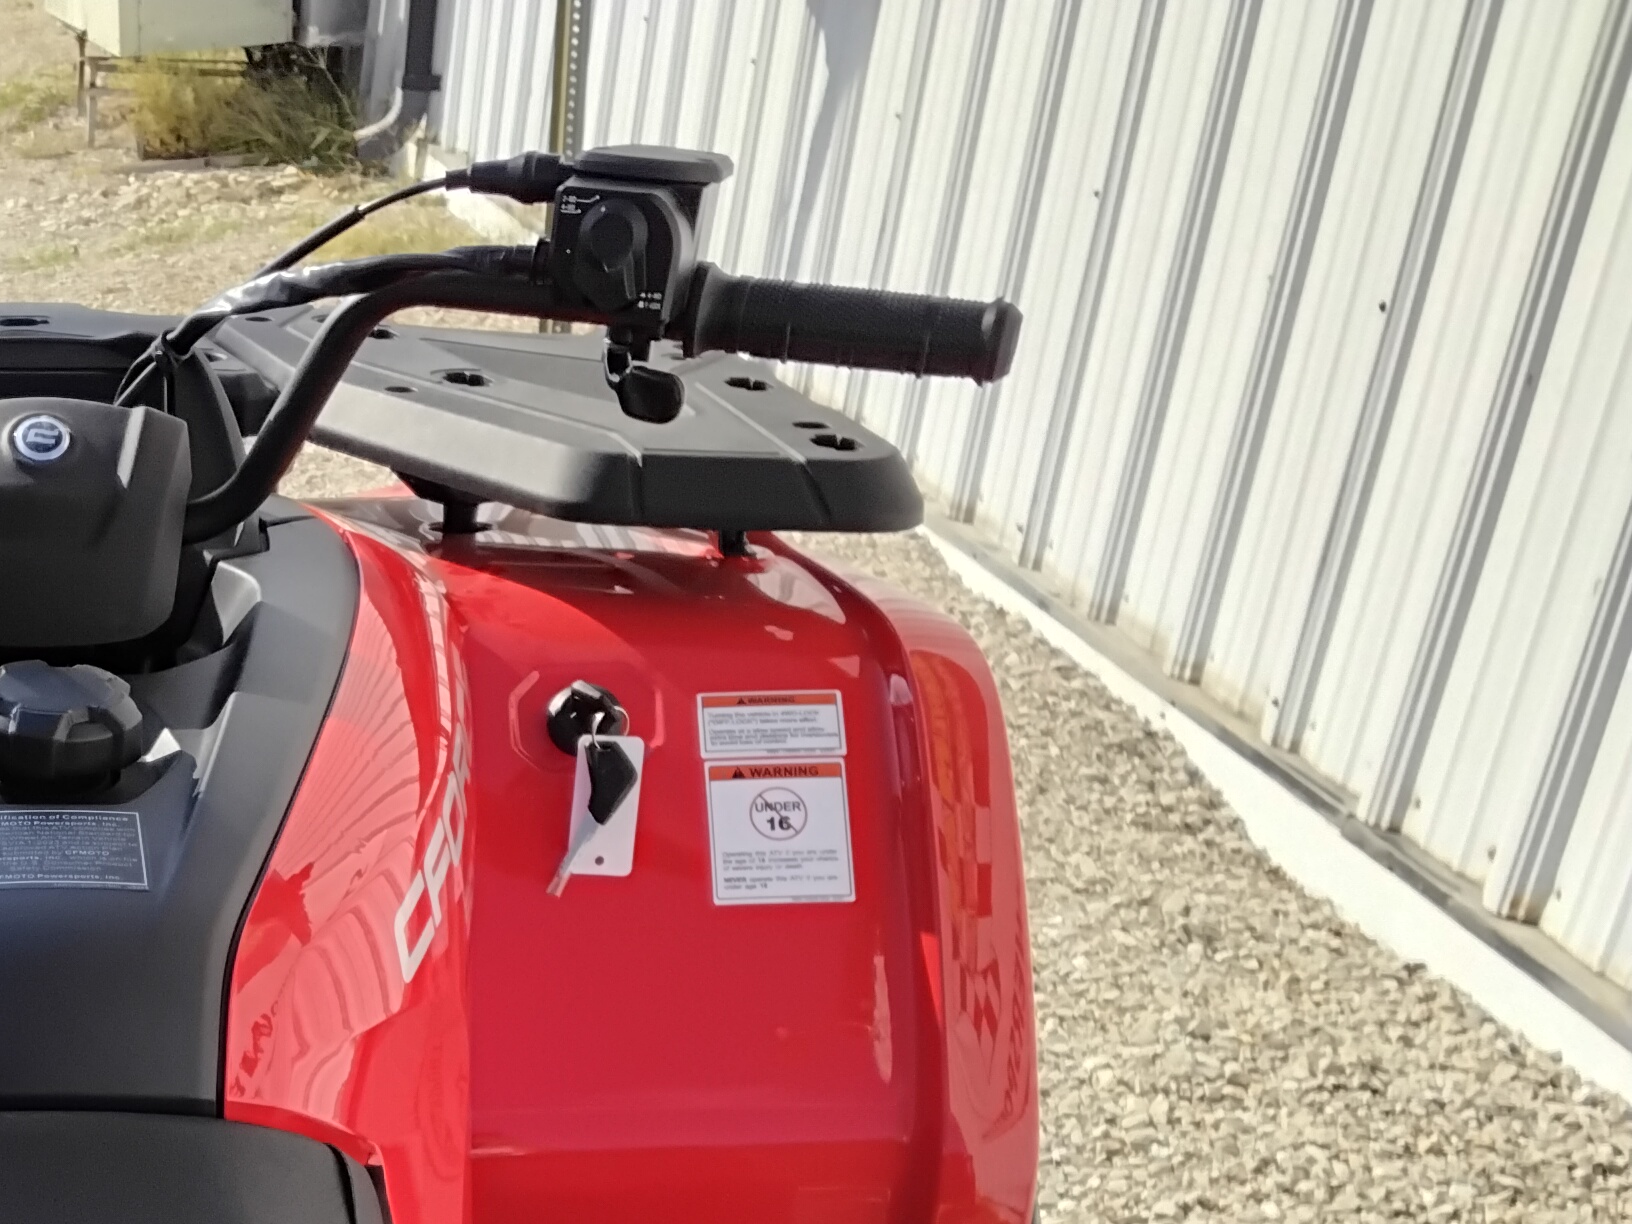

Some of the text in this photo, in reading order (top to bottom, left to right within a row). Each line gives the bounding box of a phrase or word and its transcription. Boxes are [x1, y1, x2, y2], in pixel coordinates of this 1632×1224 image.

[749, 767, 819, 777] WARNING
[754, 801, 801, 812] UNDER
[767, 817, 791, 831] 16
